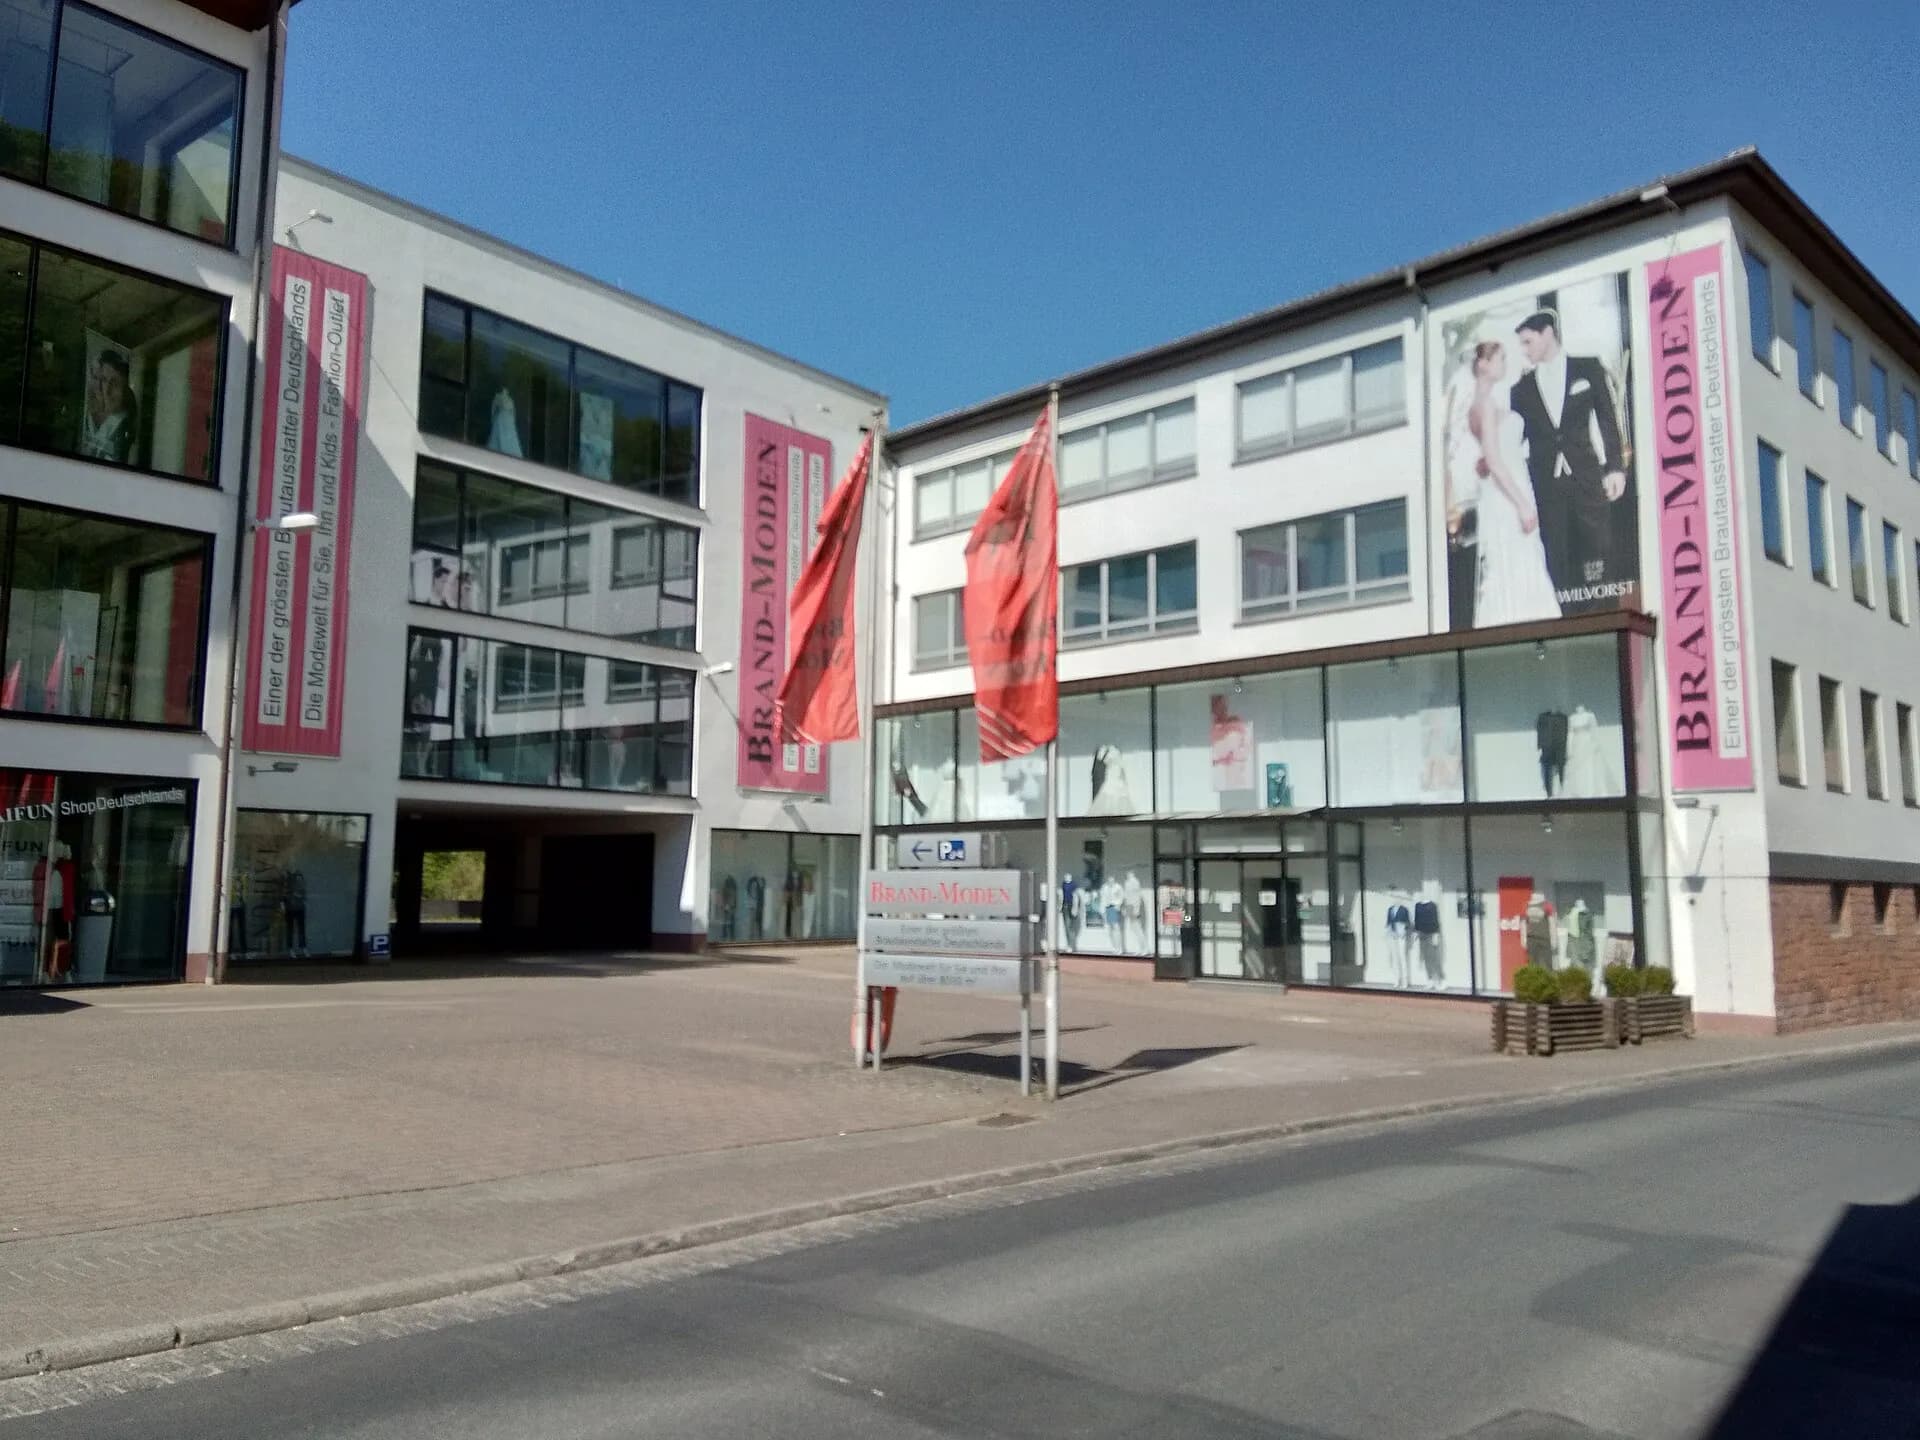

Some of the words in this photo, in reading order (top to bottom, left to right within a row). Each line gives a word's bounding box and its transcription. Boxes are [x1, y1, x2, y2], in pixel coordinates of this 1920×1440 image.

[284, 284, 306, 404] Deutschlands
[323, 297, 345, 417] Fashion-Outlet
[1703, 279, 1721, 408] Deutschlands
[322, 435, 338, 472] Kids
[322, 478, 337, 510] und
[1711, 414, 1731, 561] Brautausstatter
[272, 550, 291, 627] grössten
[312, 581, 329, 601] für
[748, 441, 777, 763] BRAND-MODEN
[1557, 580, 1635, 603] WILVORST
[1716, 568, 1738, 651] grössten
[271, 633, 285, 664] der
[307, 606, 327, 687] Modewelt
[264, 667, 283, 717] Einer
[1721, 659, 1737, 691] der
[305, 693, 322, 721] Die
[1725, 697, 1741, 750] Einer
[870, 880, 1012, 905] BRAND-MODEN
[373, 936, 389, 951] P
